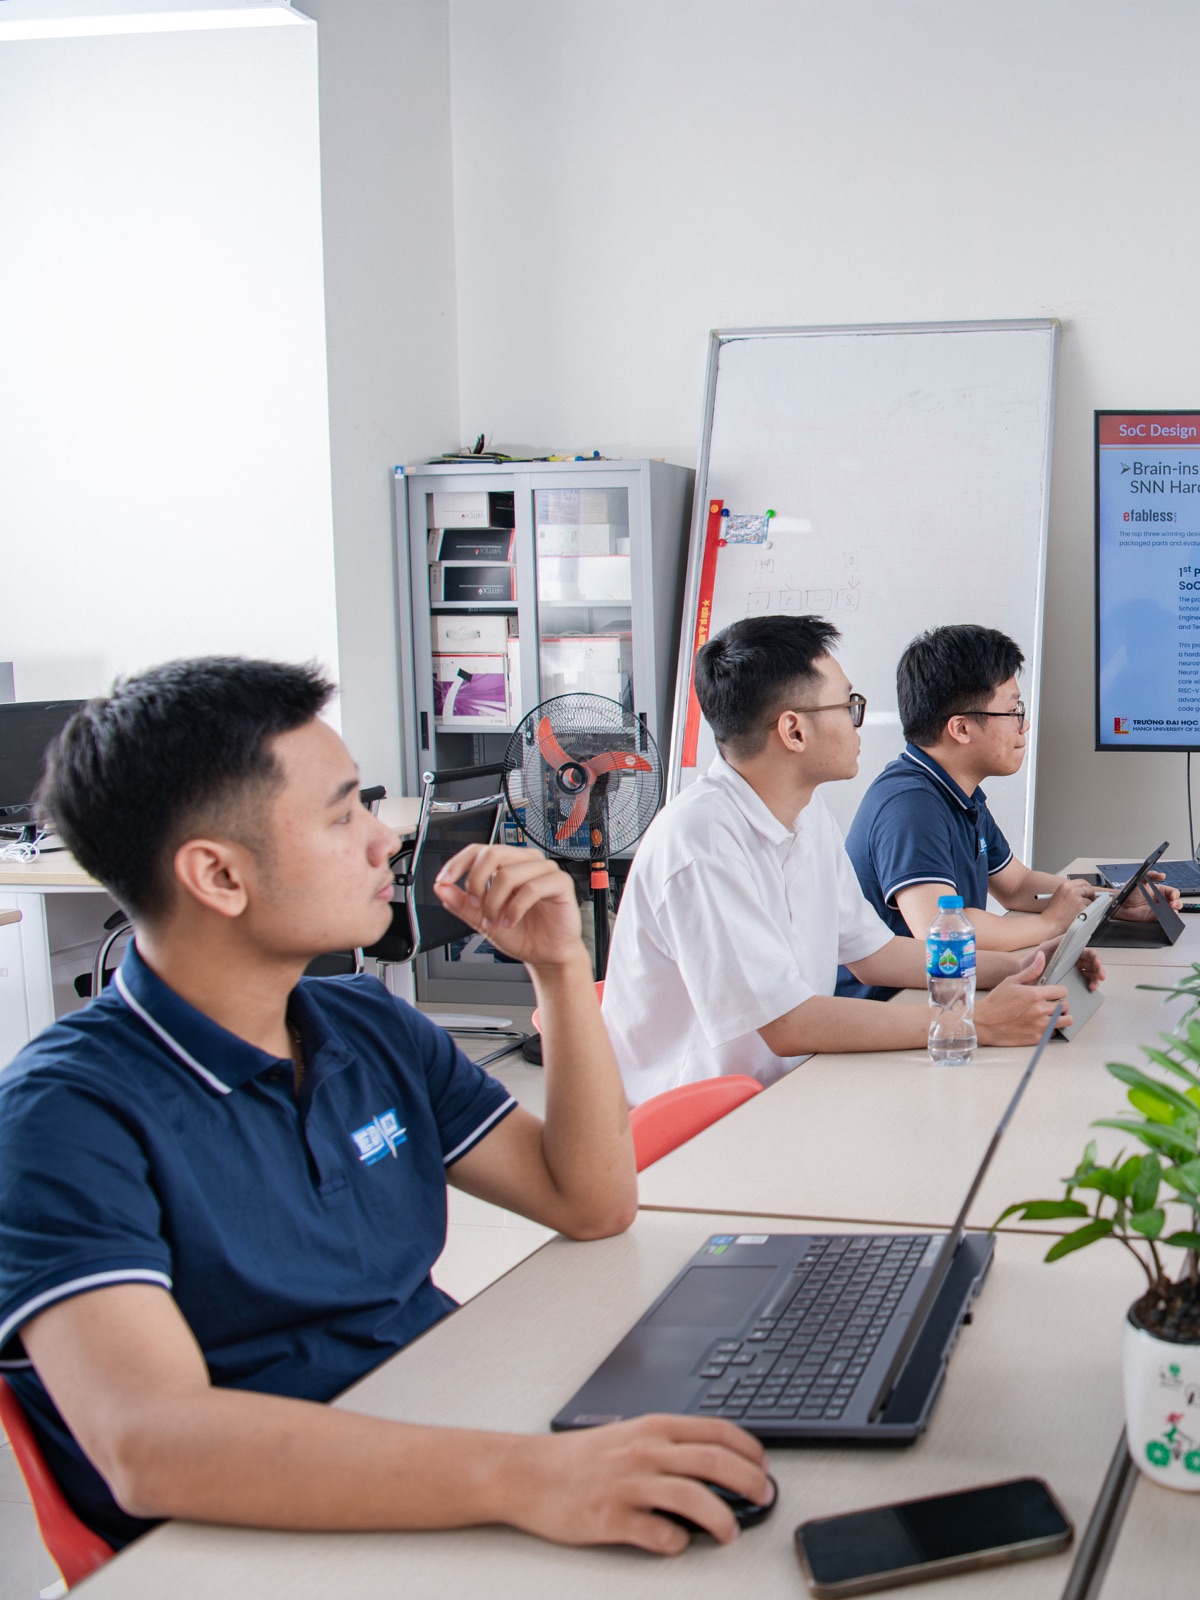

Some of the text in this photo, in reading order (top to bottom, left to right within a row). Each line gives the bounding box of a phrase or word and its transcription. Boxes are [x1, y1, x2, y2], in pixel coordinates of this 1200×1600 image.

[1119, 424, 1146, 437] SoC
[1150, 424, 1197, 439] Design
[1130, 480, 1165, 494] SNN
[1131, 531, 1143, 539] top
